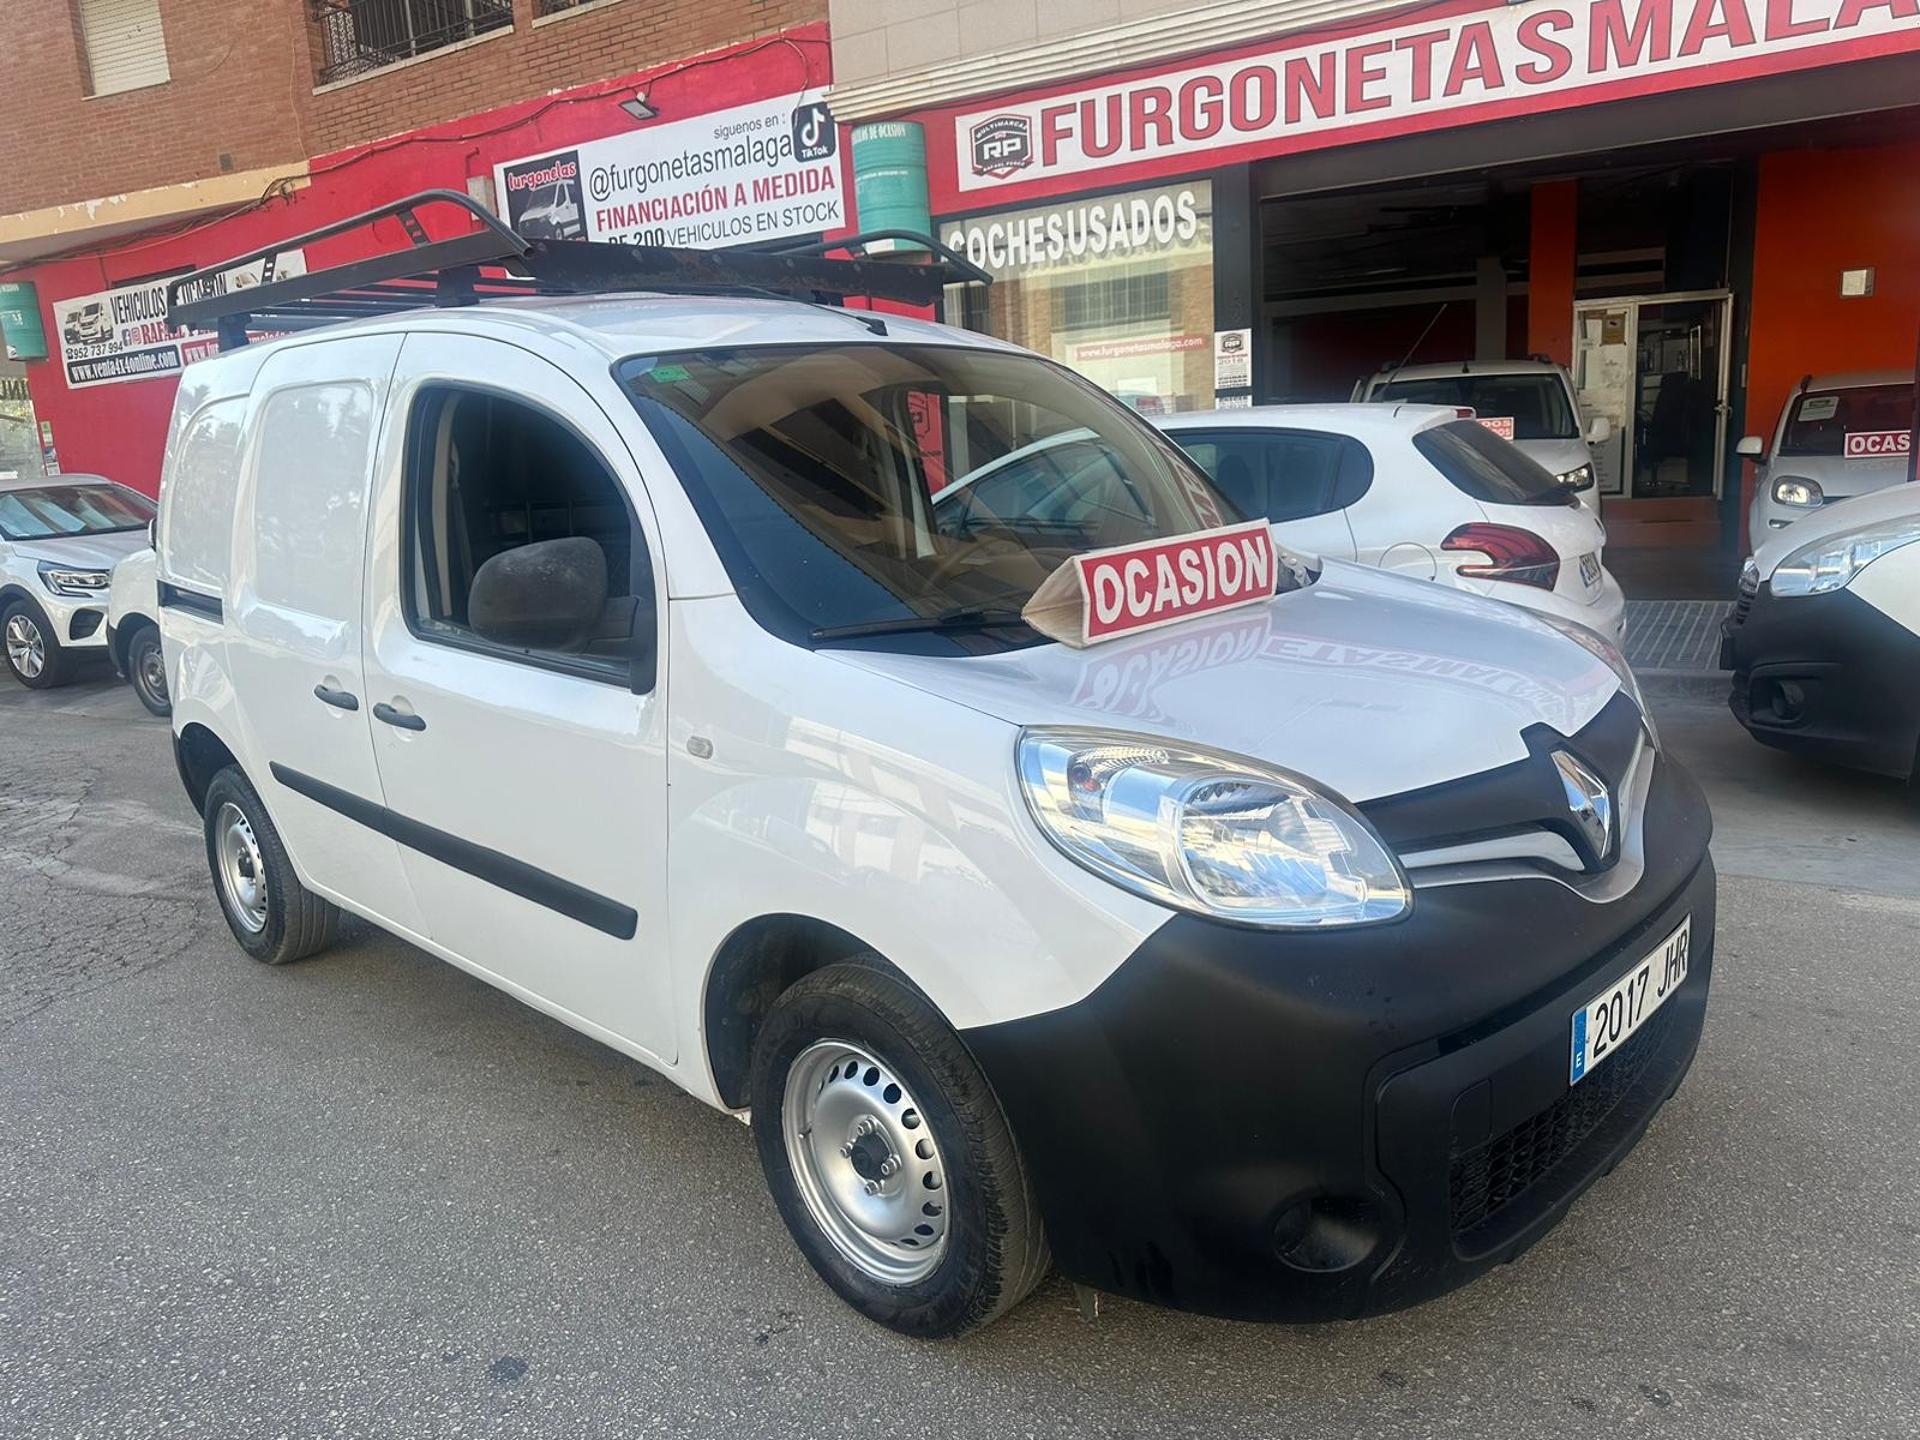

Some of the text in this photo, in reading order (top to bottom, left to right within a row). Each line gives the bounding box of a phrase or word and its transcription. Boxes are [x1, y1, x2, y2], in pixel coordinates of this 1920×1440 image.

[714, 119, 762, 140] siguenos
[765, 115, 779, 128] en
[801, 145, 829, 159] TikTok
[983, 137, 1021, 160] RP
[590, 134, 793, 202] @furgonetasmalaga
[596, 165, 835, 232] FINANCIACIÓN A MEDIDA
[666, 215, 752, 246] VEHICULOS
[756, 211, 778, 232] EN
[783, 200, 839, 227] STOCK
[110, 286, 166, 325] VEHICULOS
[73, 341, 123, 359] 952 737 994
[1850, 434, 1911, 453] OCAS
[1092, 536, 1268, 624] OCASION
[1593, 929, 1688, 1059] 2017 JHR
[1576, 1051, 1583, 1068] E
